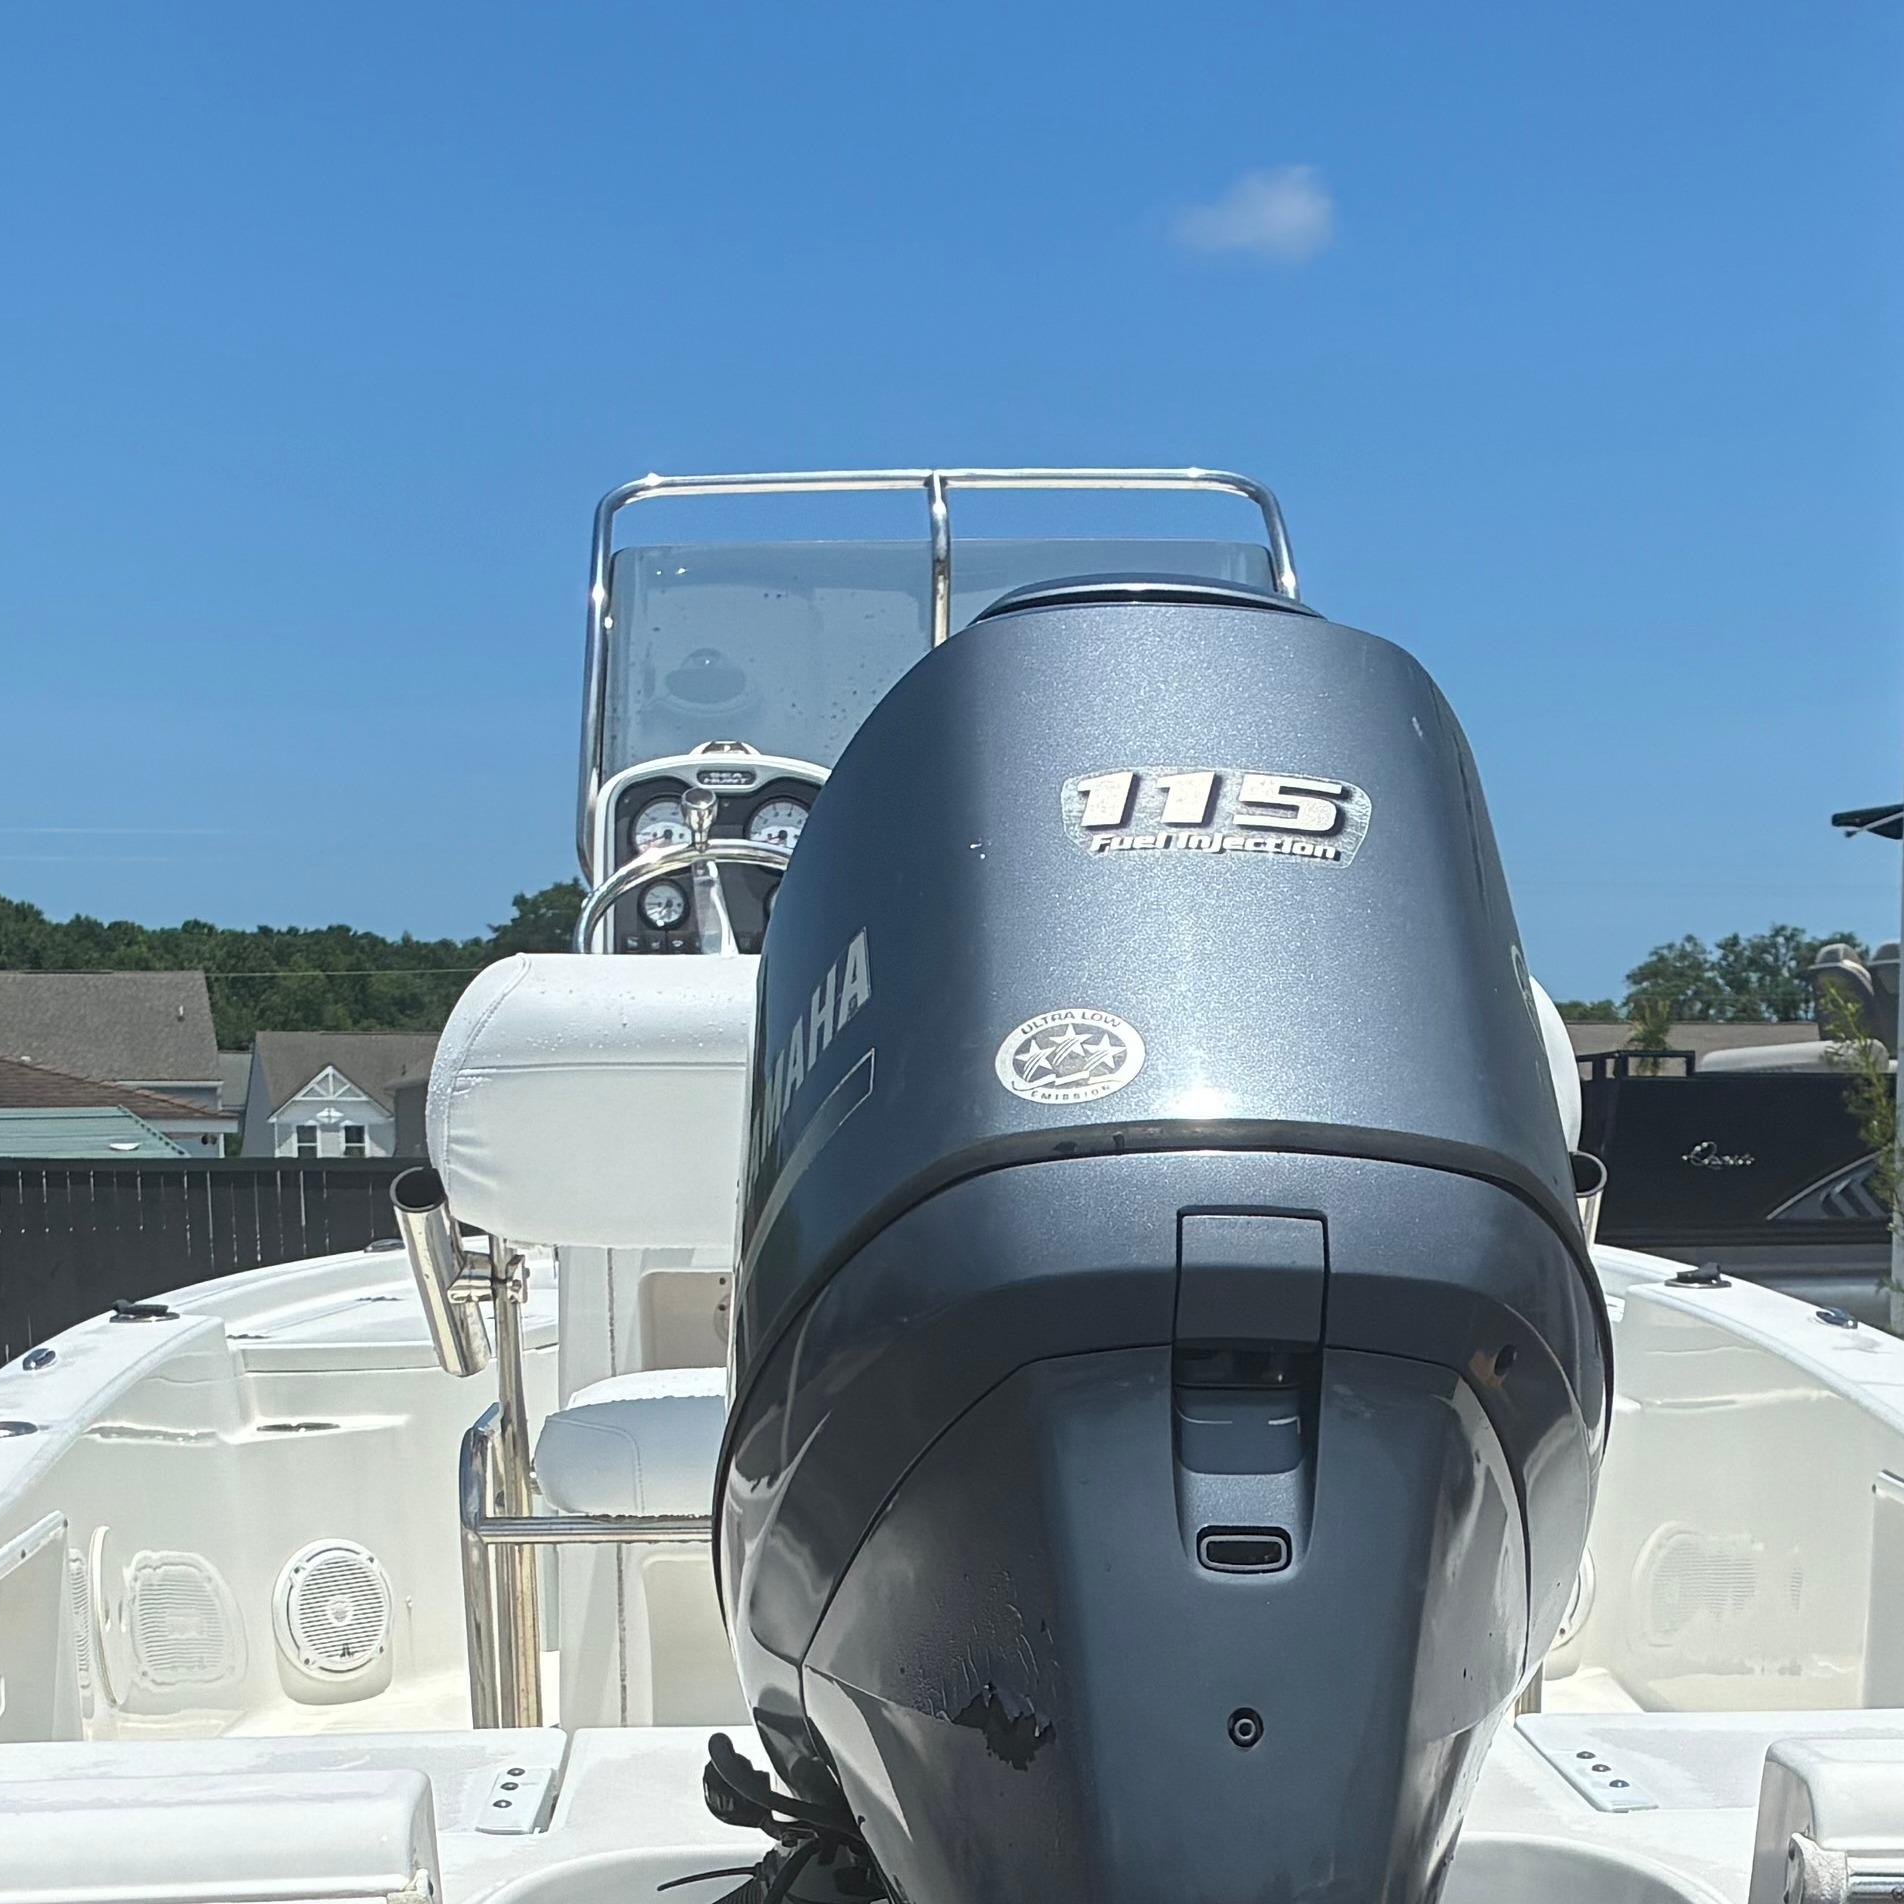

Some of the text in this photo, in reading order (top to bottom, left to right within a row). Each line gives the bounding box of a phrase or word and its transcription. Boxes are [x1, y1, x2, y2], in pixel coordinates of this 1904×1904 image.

[1077, 771, 1348, 834] 115
[1089, 832, 1341, 861] Fuel Injection
[1021, 1011, 1122, 1035] ULTRA LOW
